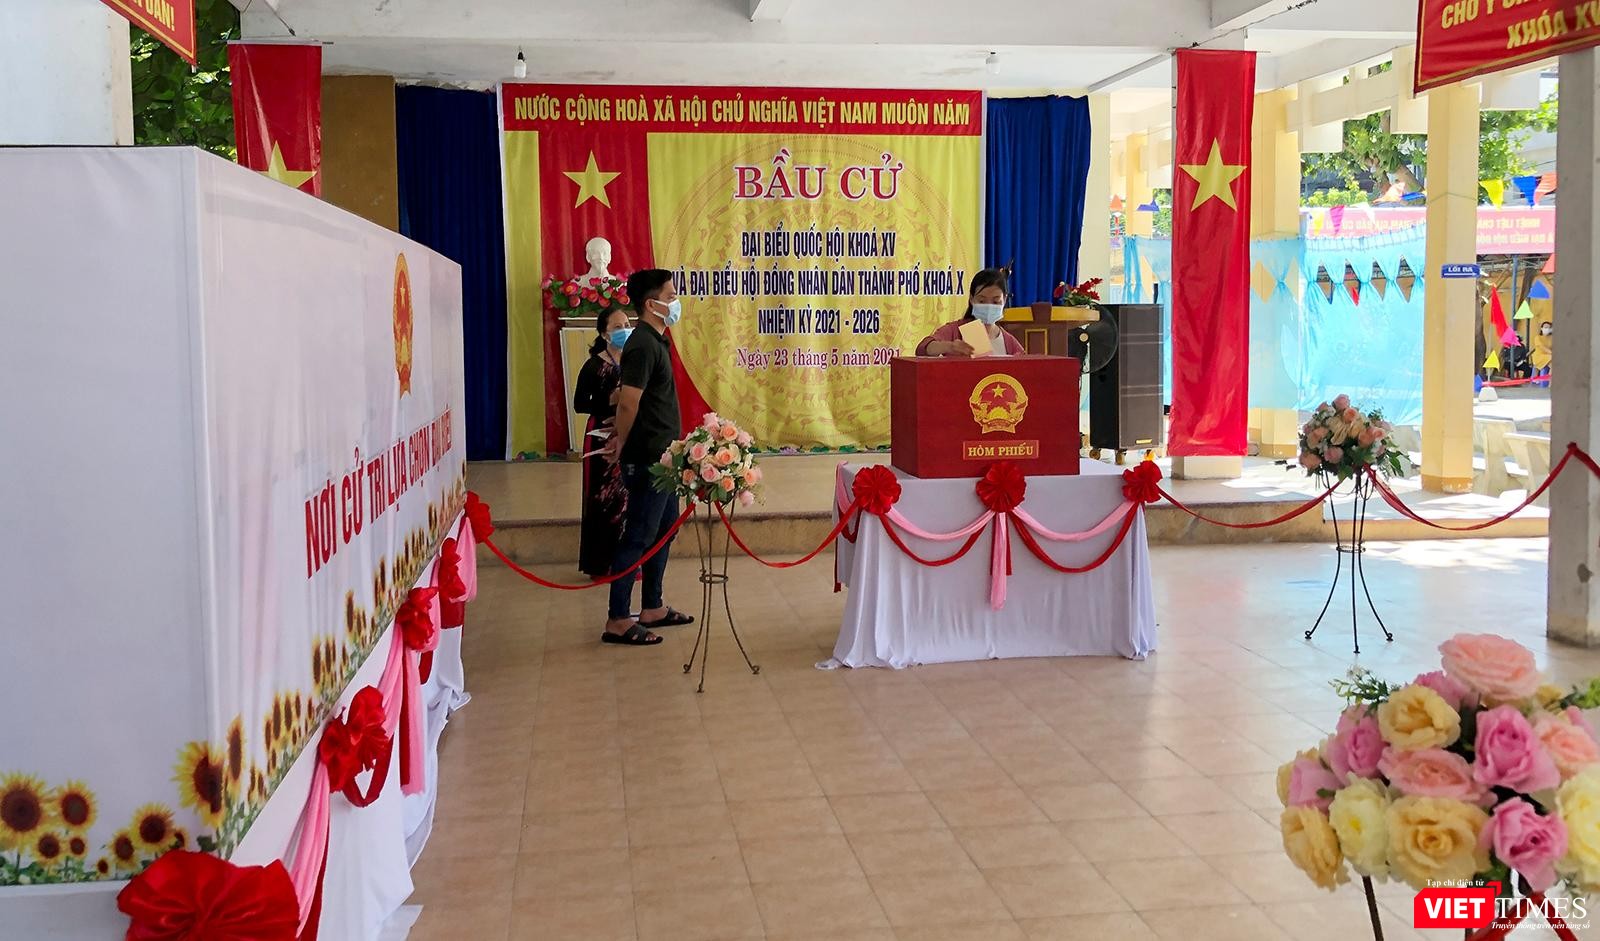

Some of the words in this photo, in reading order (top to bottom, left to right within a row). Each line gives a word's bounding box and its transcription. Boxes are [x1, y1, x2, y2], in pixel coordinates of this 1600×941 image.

[1507, 9, 1568, 49] KHÓA
[514, 93, 560, 120] NƯỚC
[565, 93, 611, 126] CỘNG
[615, 94, 649, 121] HOÀ
[653, 95, 676, 122] XÃ
[680, 95, 707, 127] HỘI
[712, 92, 744, 122] CHỦ
[749, 96, 798, 123] NGHĨA
[802, 96, 836, 128] VIỆT
[840, 101, 877, 124] NAM
[881, 98, 929, 125] MUÔN
[933, 98, 970, 125] NĂM
[734, 148, 827, 200] BẦU
[839, 153, 903, 200] CỬ
[741, 231, 761, 262] ĐẠI
[764, 221, 790, 257] BIỂU
[793, 223, 823, 259] QUỐC
[826, 226, 845, 262] HỘI
[847, 227, 878, 257] KHOÁ
[881, 232, 896, 257] XV
[672, 266, 687, 295] VÀ
[690, 270, 709, 301] ĐẠI
[713, 260, 738, 295] BIỂU
[741, 266, 760, 301] HỘI
[763, 263, 794, 295] ĐỒNG
[798, 266, 828, 295] NHÂN
[832, 266, 854, 295] DÂN
[858, 266, 895, 295] THÀNH
[898, 262, 921, 295] PHỐ
[923, 266, 953, 295] KHOÁ
[956, 270, 964, 295] X
[758, 304, 795, 339] NHIỆM
[799, 304, 812, 334] KỲ
[815, 309, 840, 334] 2021
[852, 309, 880, 334] 2026
[737, 348, 771, 370] Ngày
[774, 348, 789, 366] 23
[792, 348, 828, 370] tháng
[831, 348, 838, 366] 5
[842, 349, 872, 366] năm
[968, 444, 994, 457] HÒM
[998, 442, 1033, 456] PHIẾU
[304, 479, 337, 579] NƠI
[341, 447, 364, 544] CỬ
[367, 454, 385, 523] TRI
[387, 437, 408, 512] LỰA
[409, 425, 430, 487] CHỌN
